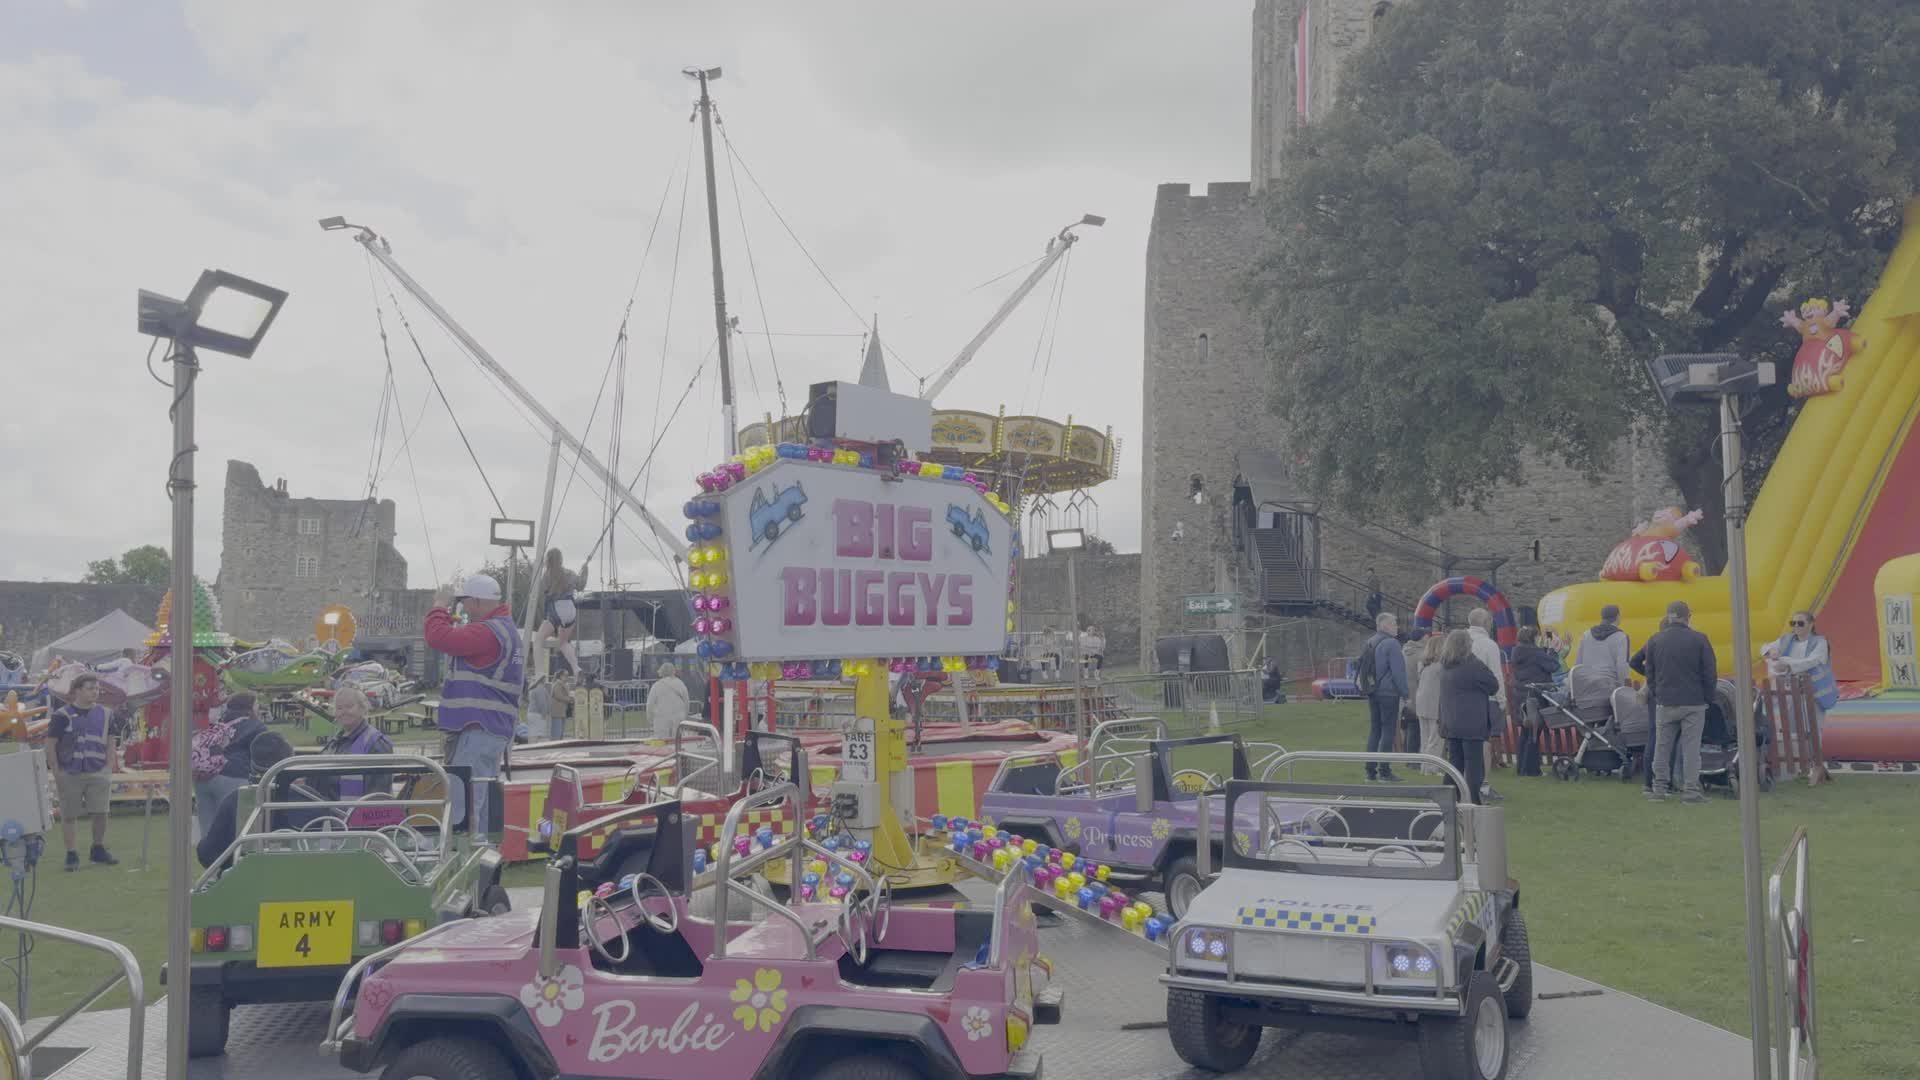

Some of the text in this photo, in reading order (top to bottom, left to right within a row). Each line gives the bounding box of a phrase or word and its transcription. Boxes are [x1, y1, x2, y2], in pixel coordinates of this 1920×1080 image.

[832, 498, 932, 561] BIG
[782, 566, 973, 626] BUGGYS
[844, 732, 871, 742] FARE
[848, 743, 868, 760] £3
[1083, 826, 1153, 850] Prncess
[1257, 898, 1372, 911] POLICE
[280, 910, 336, 928] ARMY
[295, 933, 311, 957] 4
[588, 999, 735, 1062] Barbie
